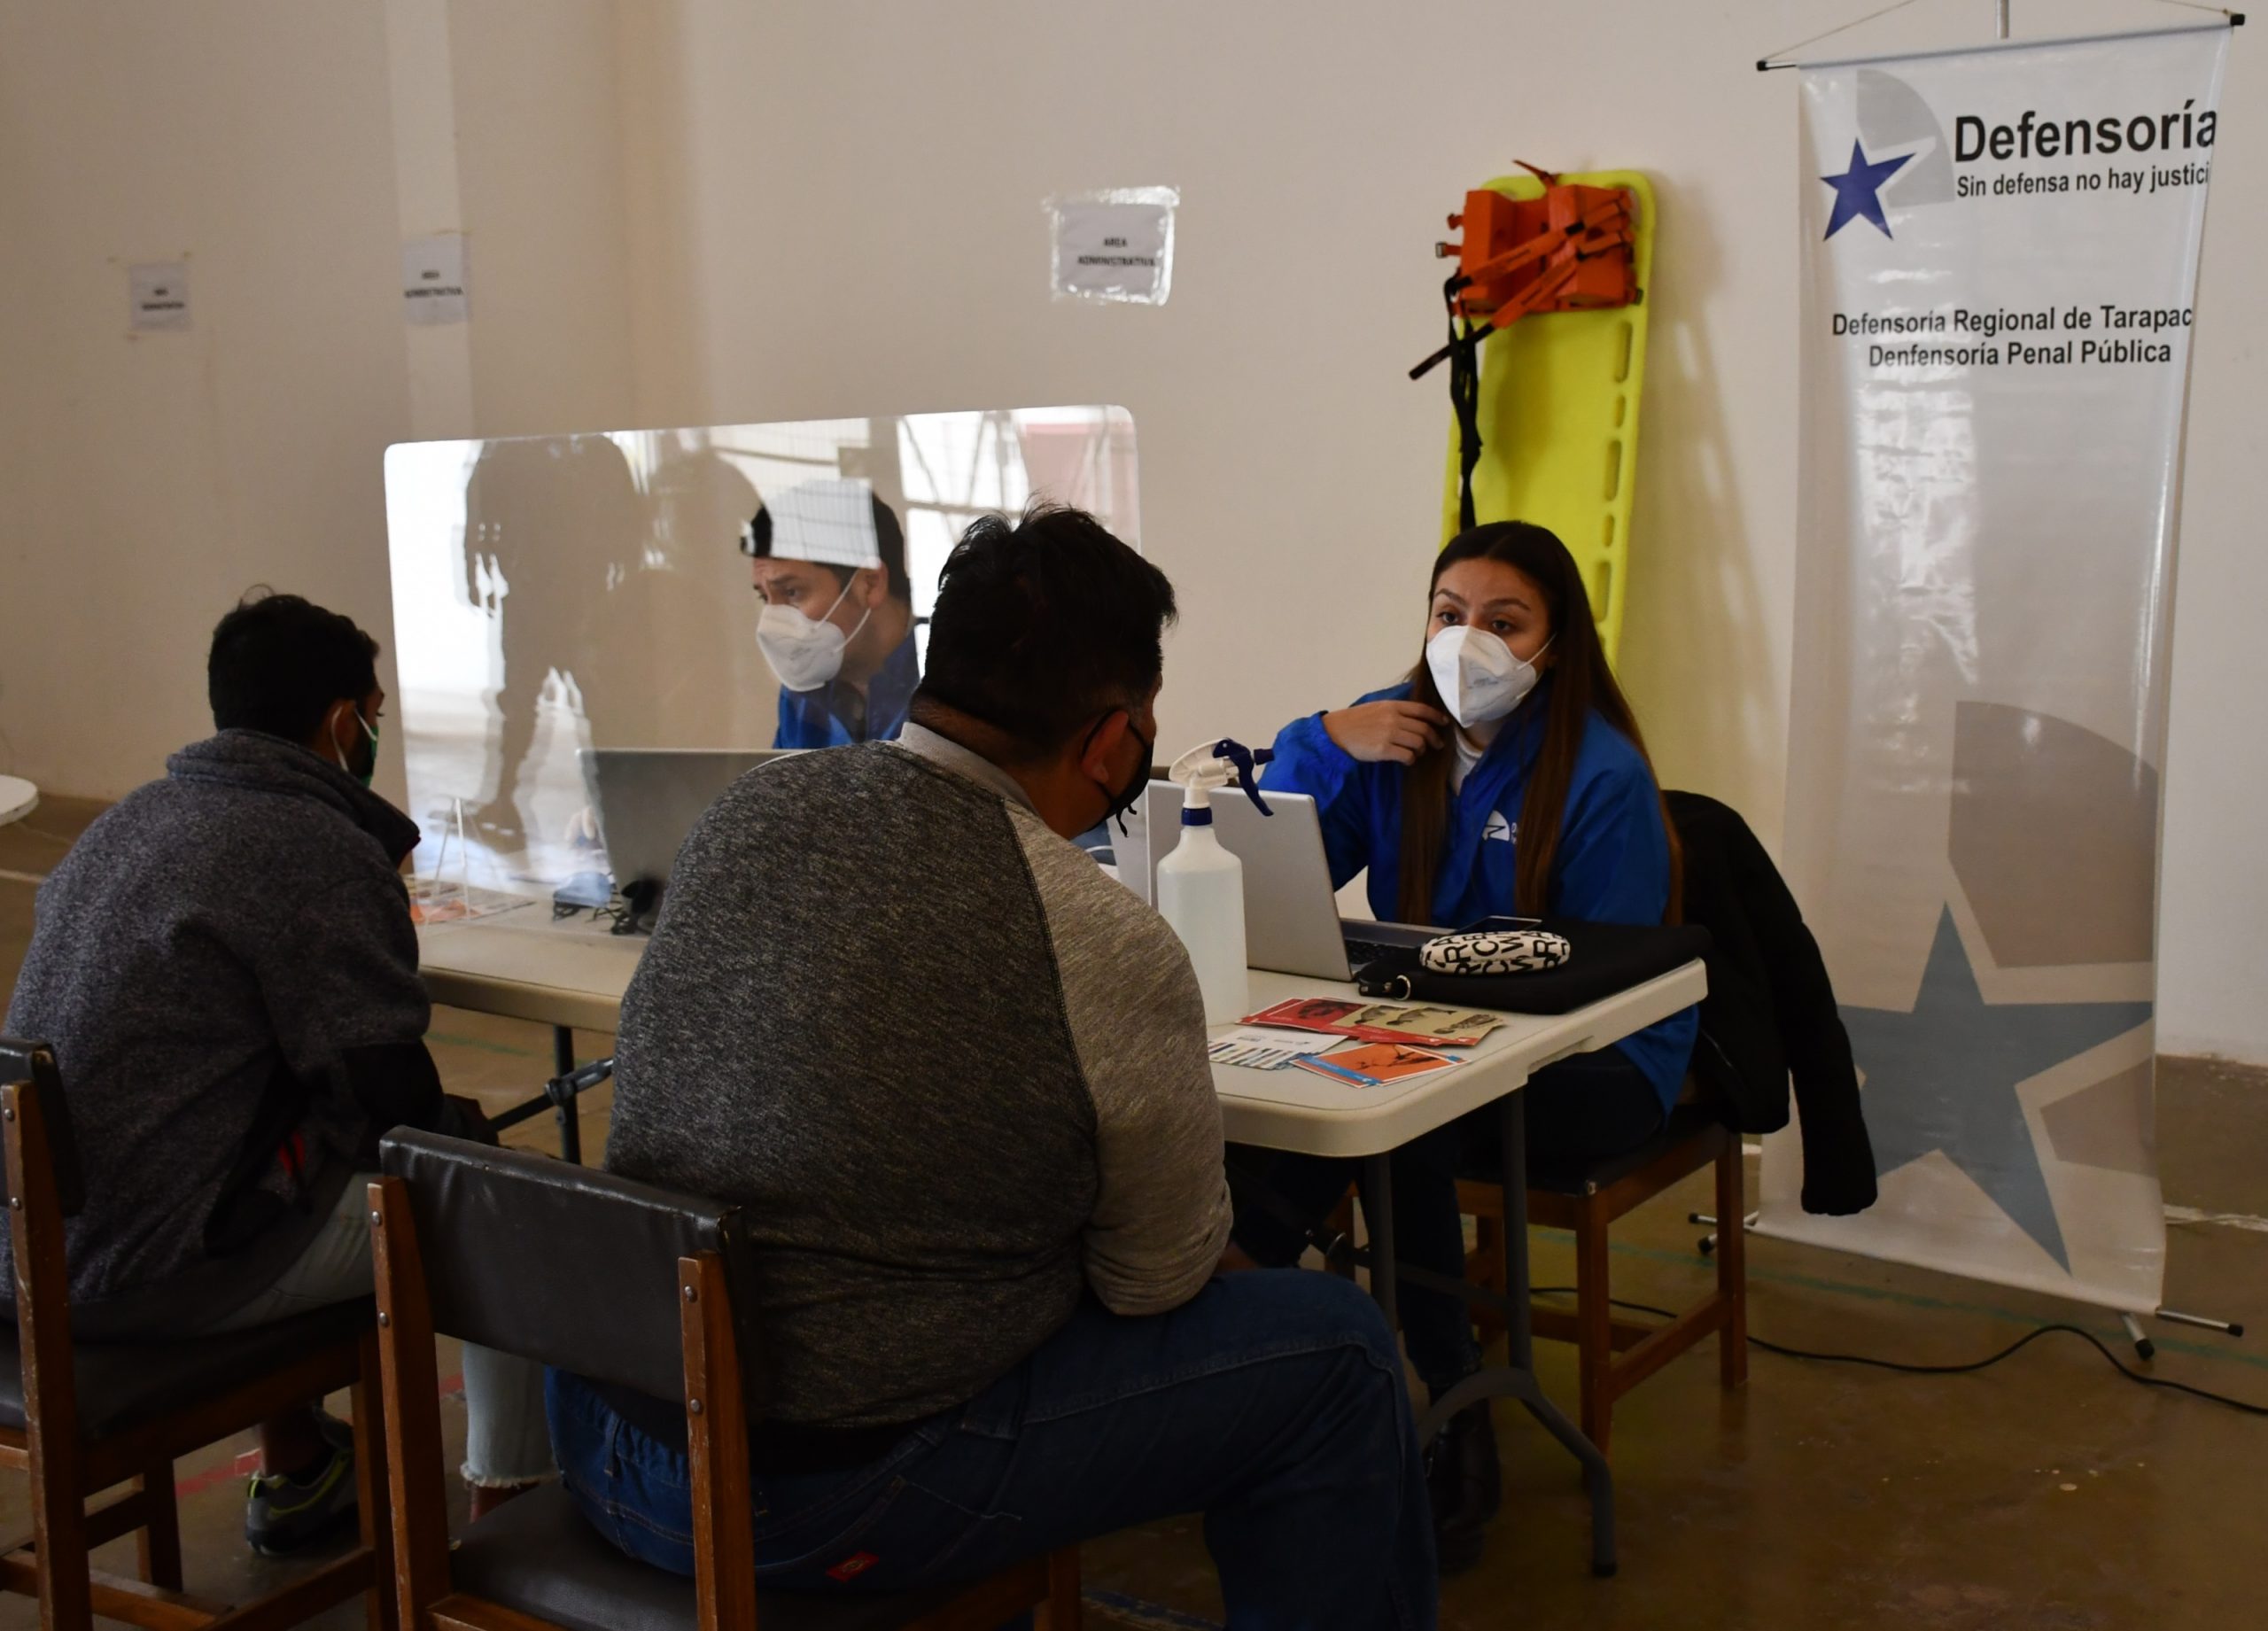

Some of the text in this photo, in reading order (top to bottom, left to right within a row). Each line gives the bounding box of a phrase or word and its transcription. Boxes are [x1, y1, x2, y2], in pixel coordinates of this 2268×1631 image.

[1955, 98, 2217, 162] Defensoría
[1957, 175, 1986, 198] Sin
[1993, 172, 2069, 195] defensa
[2076, 173, 2101, 191] no
[2108, 167, 2144, 194] hay
[1832, 310, 1946, 336] Defensoría
[1954, 307, 2055, 338] Regional
[2063, 307, 2092, 330] de
[1869, 339, 2171, 367] Denfensoría Penal Pública
